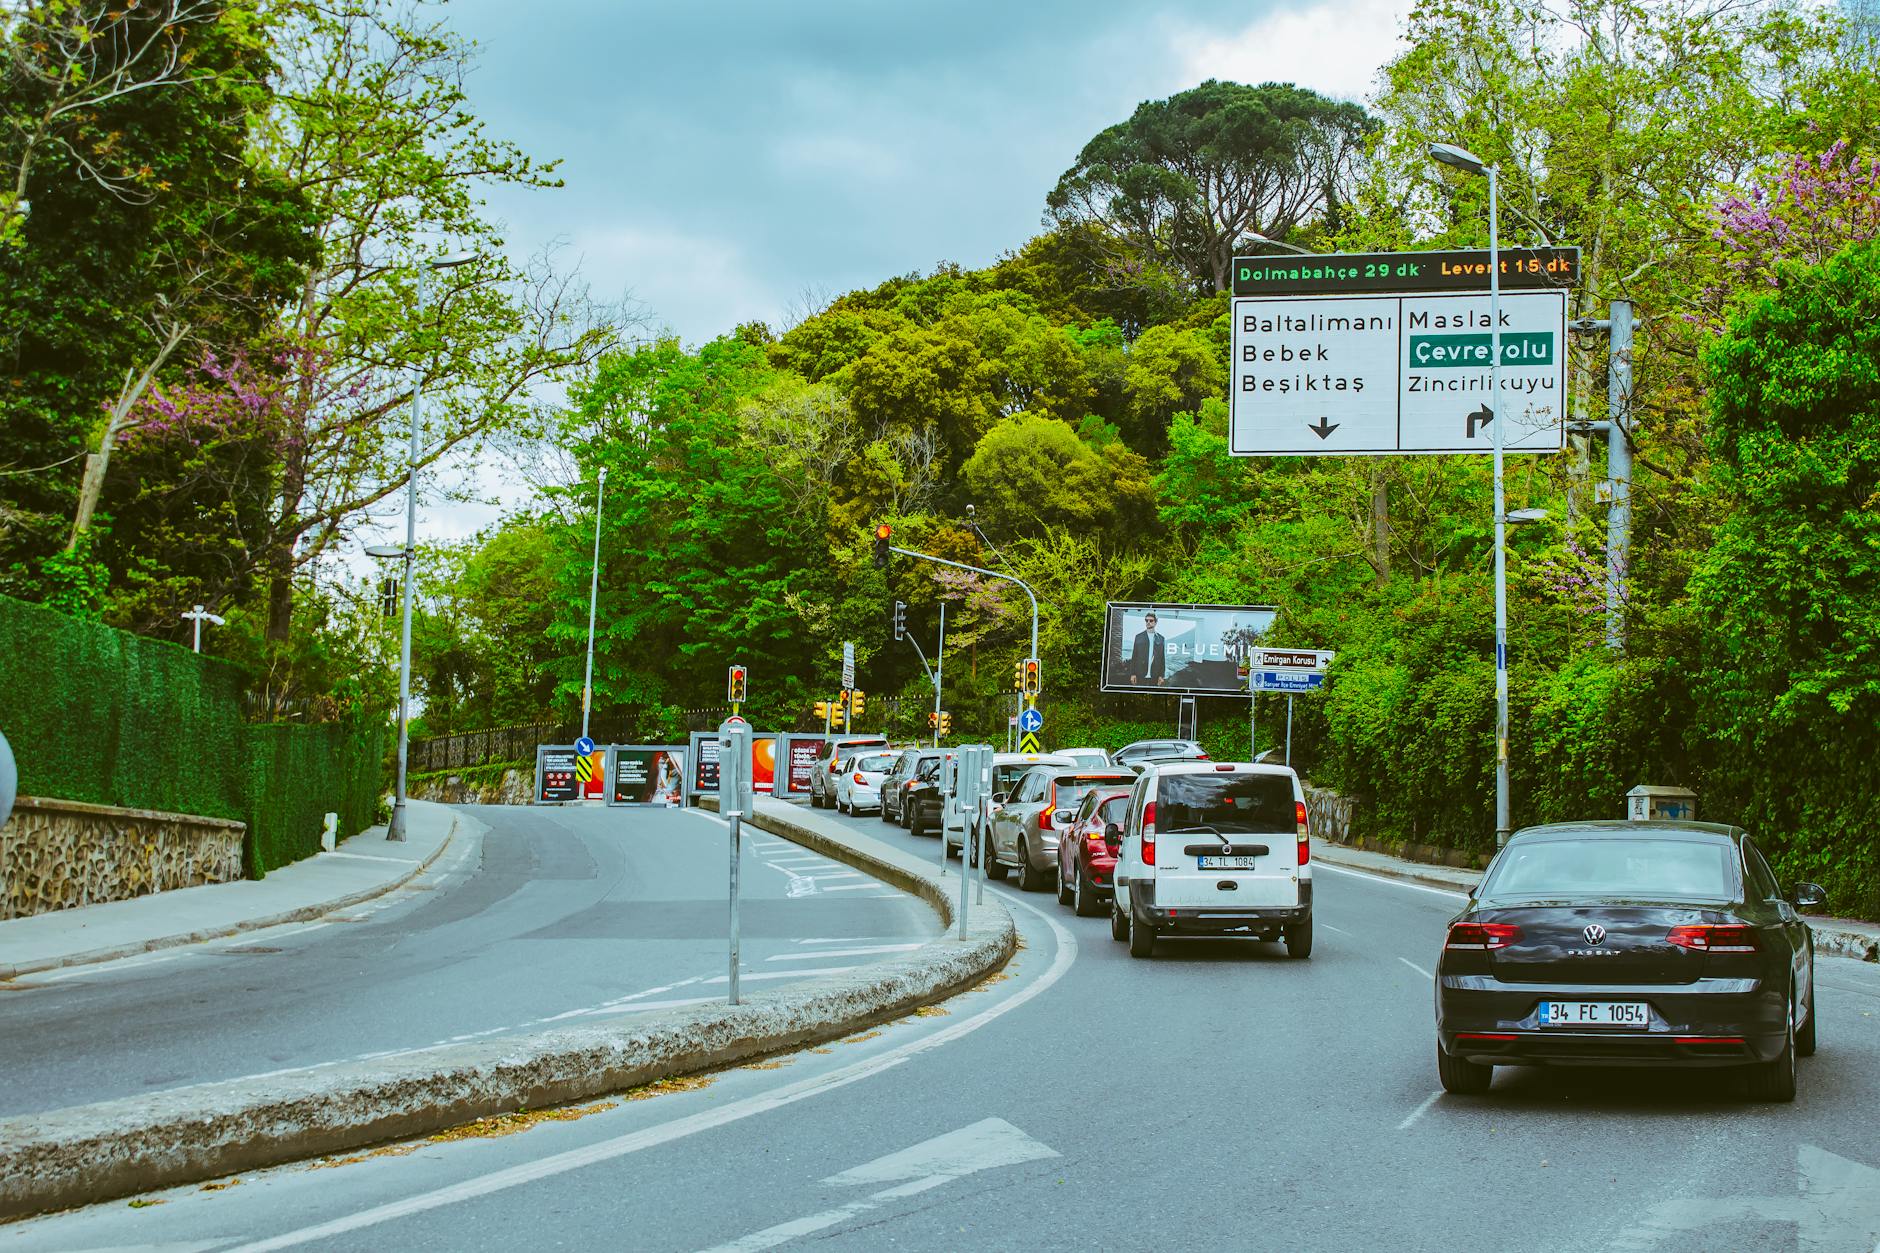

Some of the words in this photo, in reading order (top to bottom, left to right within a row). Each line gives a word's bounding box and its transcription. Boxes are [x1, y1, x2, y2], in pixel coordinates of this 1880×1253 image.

[1240, 264, 1358, 282] Dolmabahçe
[1365, 264, 1390, 278] 29
[1397, 263, 1419, 277] dk
[1515, 259, 1540, 273] 15
[1547, 258, 1570, 273] dk
[1243, 315, 1392, 333] Baltalimanı
[1409, 309, 1510, 329] Maslak
[1243, 343, 1329, 362] Bebek
[1242, 373, 1364, 394] Beşiktaş
[1264, 654, 1291, 666] Emirgan
[1293, 655, 1316, 666] Korusu
[1203, 857, 1214, 866] 34
[1219, 857, 1229, 866] TL
[1234, 857, 1253, 866] 1084
[1550, 1004, 1569, 1021] 34
[1579, 1004, 1598, 1021] FC
[1608, 1005, 1644, 1022] 1054
